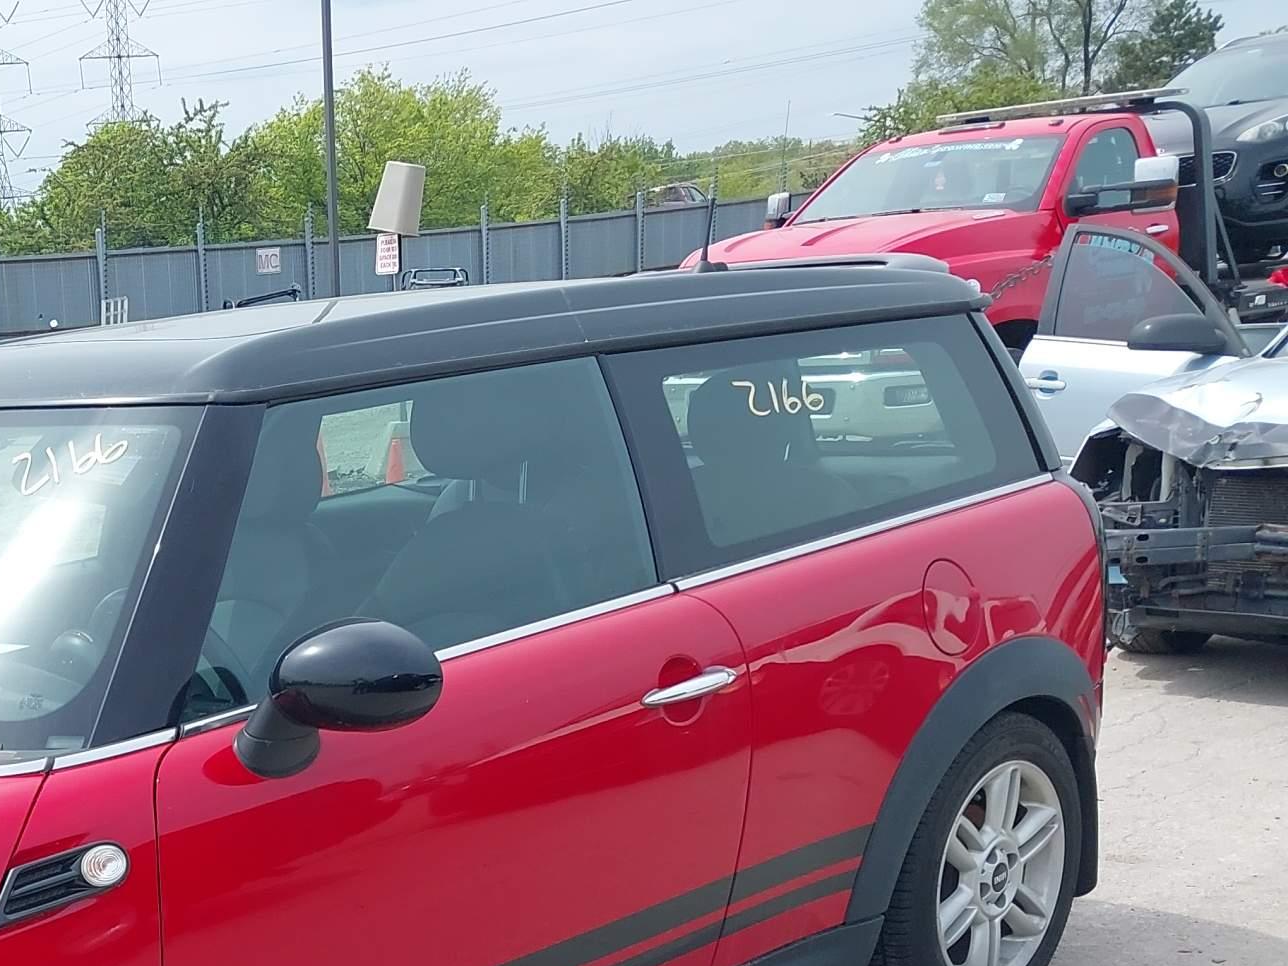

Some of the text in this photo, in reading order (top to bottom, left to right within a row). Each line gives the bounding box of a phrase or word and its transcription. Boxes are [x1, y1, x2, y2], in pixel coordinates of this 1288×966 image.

[258, 253, 281, 270] MC
[731, 377, 825, 417] 2166
[11, 432, 128, 496] 2166
